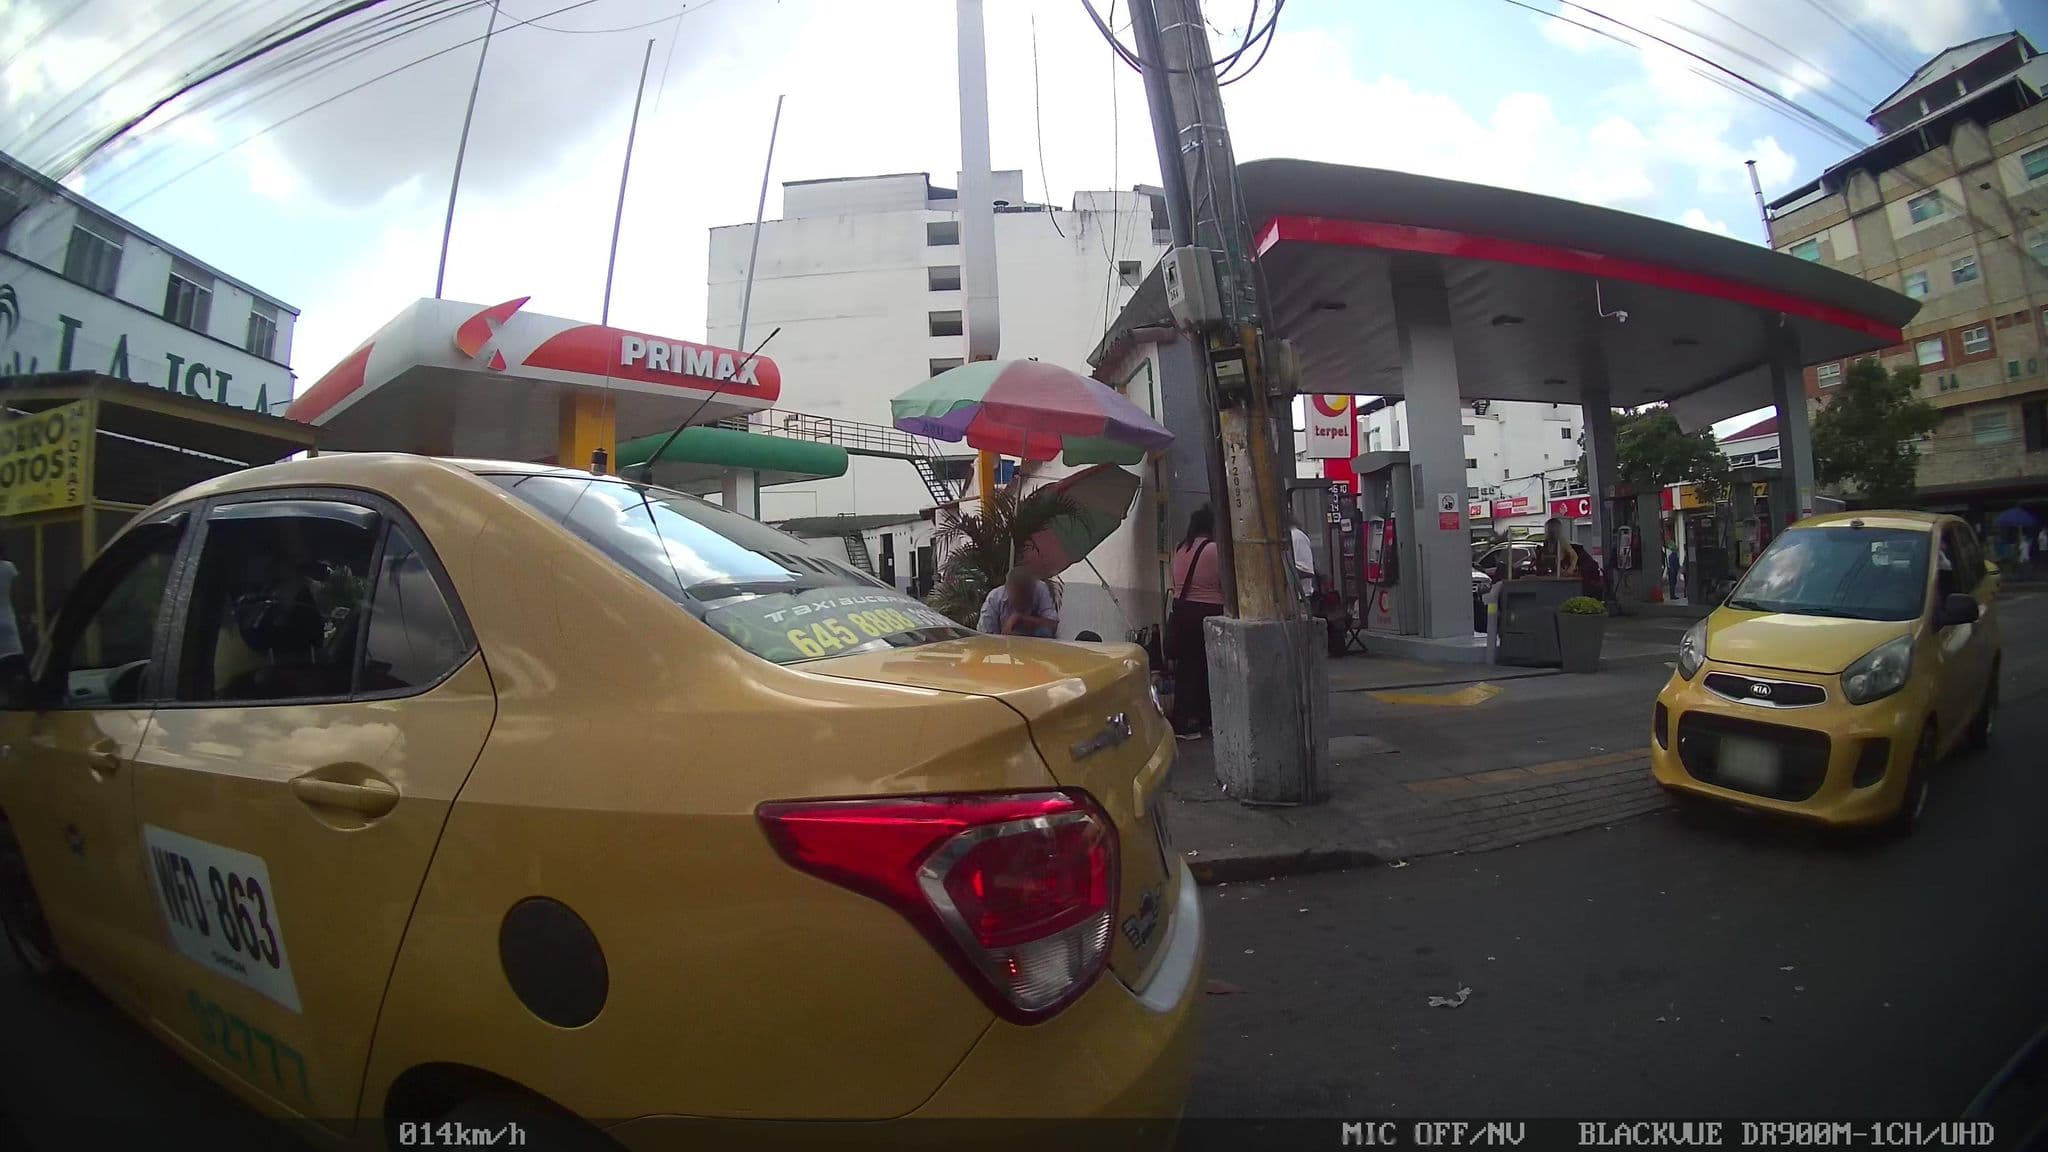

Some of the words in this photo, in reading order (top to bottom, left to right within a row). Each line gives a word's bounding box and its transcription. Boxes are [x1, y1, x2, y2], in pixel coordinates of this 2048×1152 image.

[620, 335, 760, 387] PRIMAX
[1315, 425, 1349, 439] terpel
[786, 617, 860, 658] 645
[1752, 684, 1770, 695] KIA
[208, 865, 281, 970] 863
